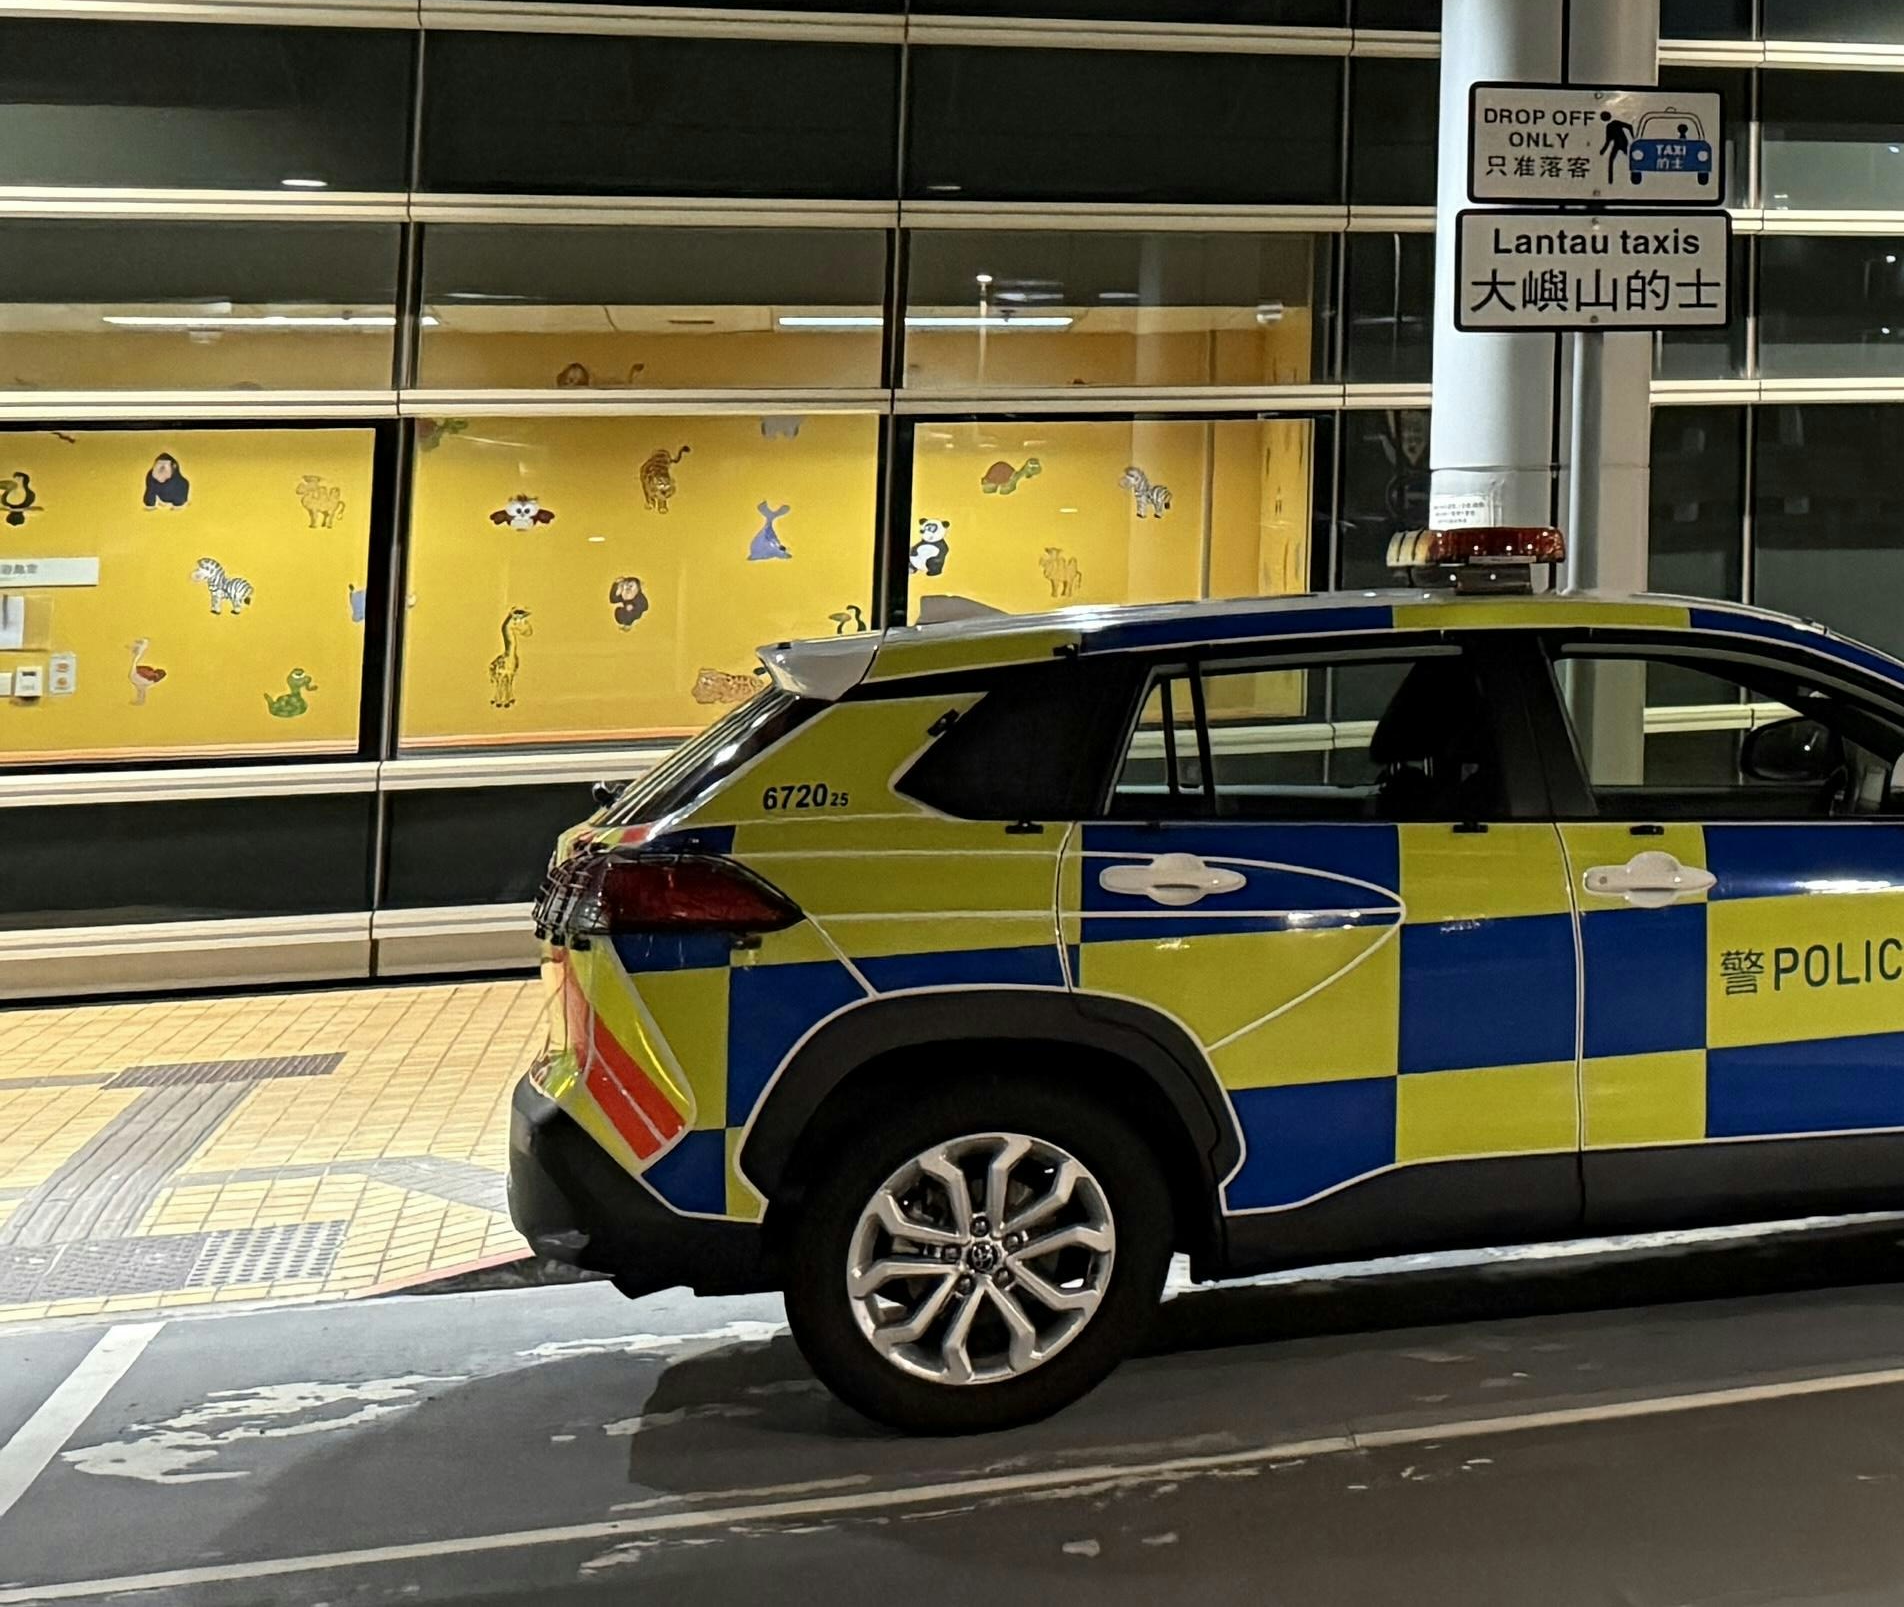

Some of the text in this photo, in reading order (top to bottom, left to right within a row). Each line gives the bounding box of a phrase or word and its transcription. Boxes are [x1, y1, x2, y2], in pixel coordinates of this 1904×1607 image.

[1484, 108, 1596, 126] DROP OFF
[1509, 132, 1569, 148] ONLY
[1656, 144, 1686, 155] TAXI
[1486, 156, 1590, 178] 只准落客
[1494, 228, 1700, 254] Lantau taxis
[1470, 268, 1721, 313] 大嶼山的士
[763, 783, 849, 810] 6720 25
[1720, 949, 1764, 996] 警
